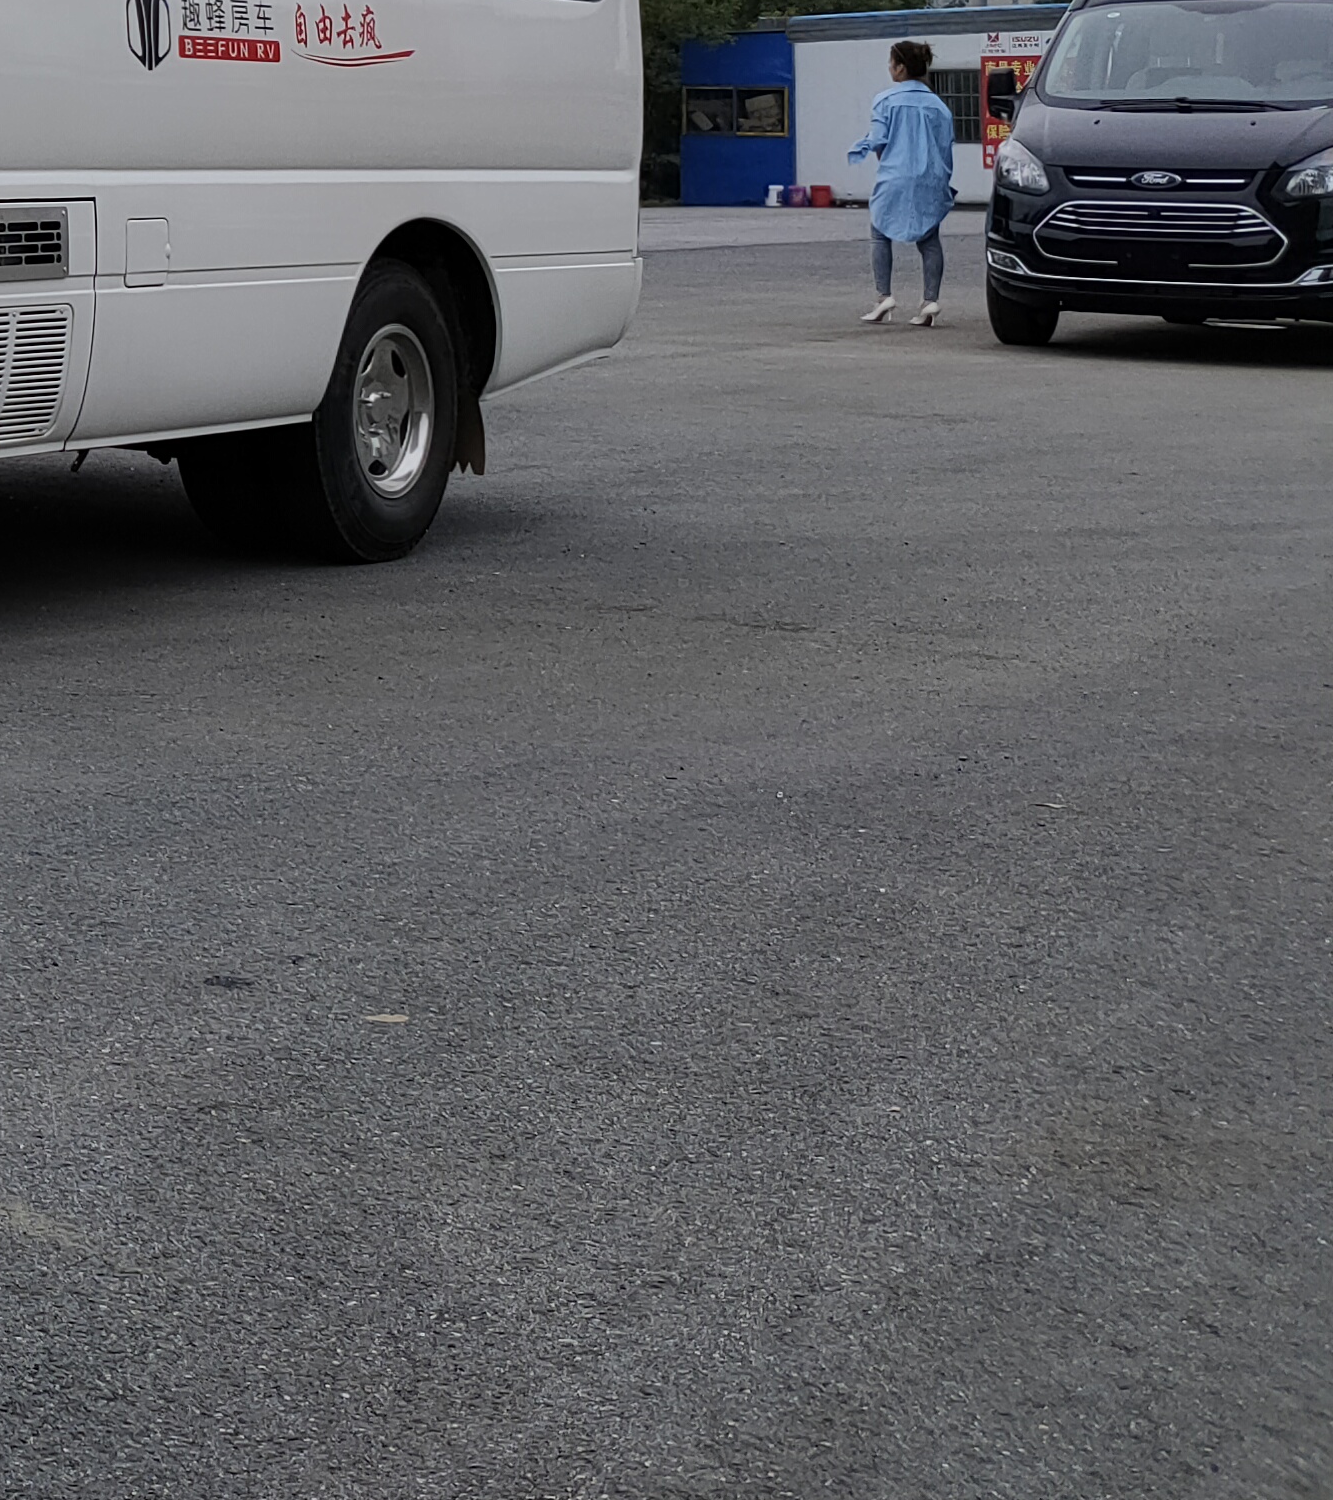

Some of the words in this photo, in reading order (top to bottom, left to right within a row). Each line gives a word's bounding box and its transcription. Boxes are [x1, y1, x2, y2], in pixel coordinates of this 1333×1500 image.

[294, 2, 382, 50] 自由去疯
[184, 38, 249, 58] BEEFUN
[255, 43, 275, 59] RV
[1141, 173, 1170, 184] Ford
